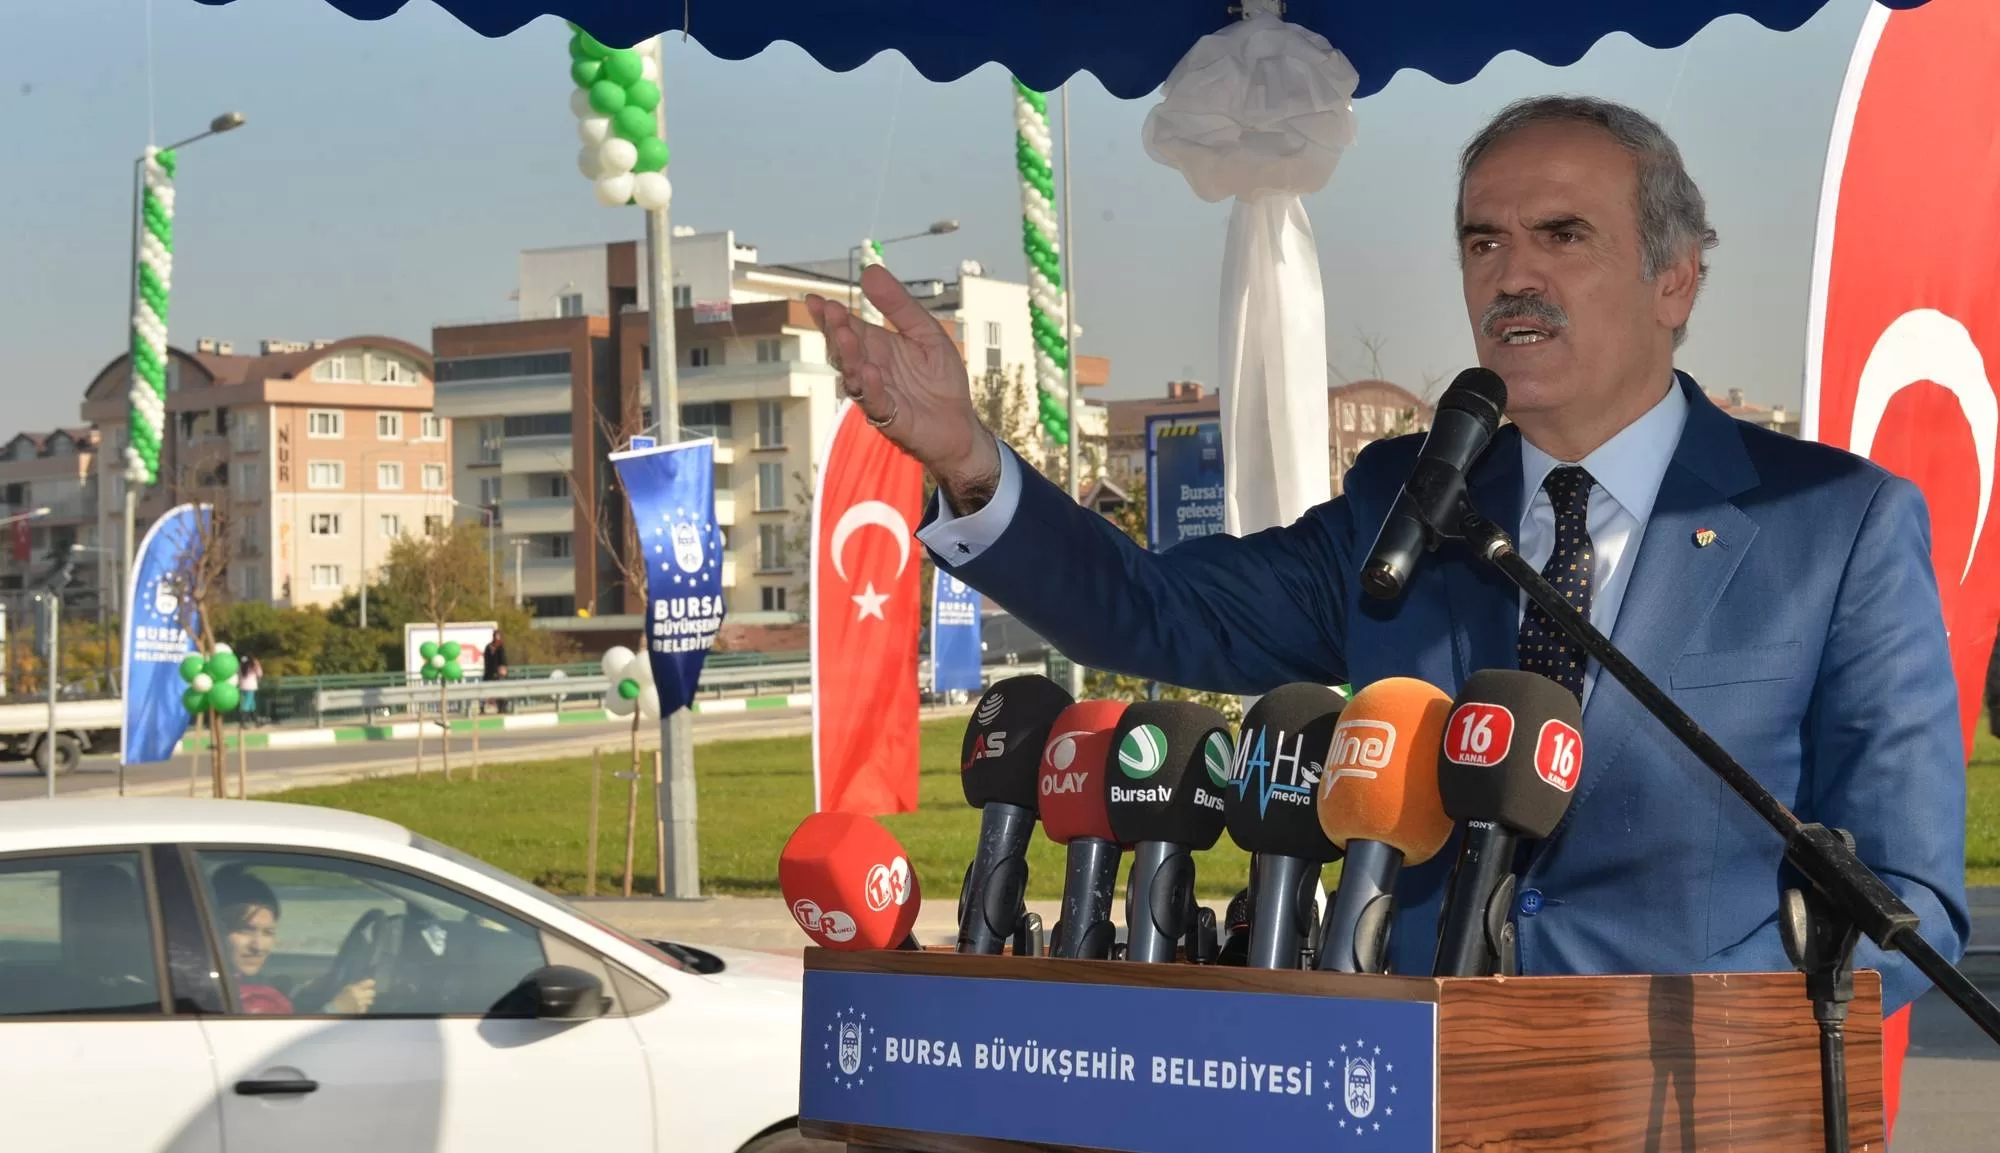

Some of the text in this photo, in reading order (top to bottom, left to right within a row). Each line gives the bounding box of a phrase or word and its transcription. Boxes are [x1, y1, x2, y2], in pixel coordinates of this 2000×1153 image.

[654, 595, 723, 621] BURSA
[1460, 711, 1494, 753] 16
[1458, 753, 1488, 764] KANAL
[1550, 732, 1576, 778] 16
[1041, 772, 1089, 796] OLAY
[1547, 772, 1568, 789] KANAL
[1271, 789, 1311, 806] medya
[1468, 820, 1497, 831] SONY
[885, 1036, 1313, 1096] BURSA BÜYÜKŞEHİR BELEDİYESİ
